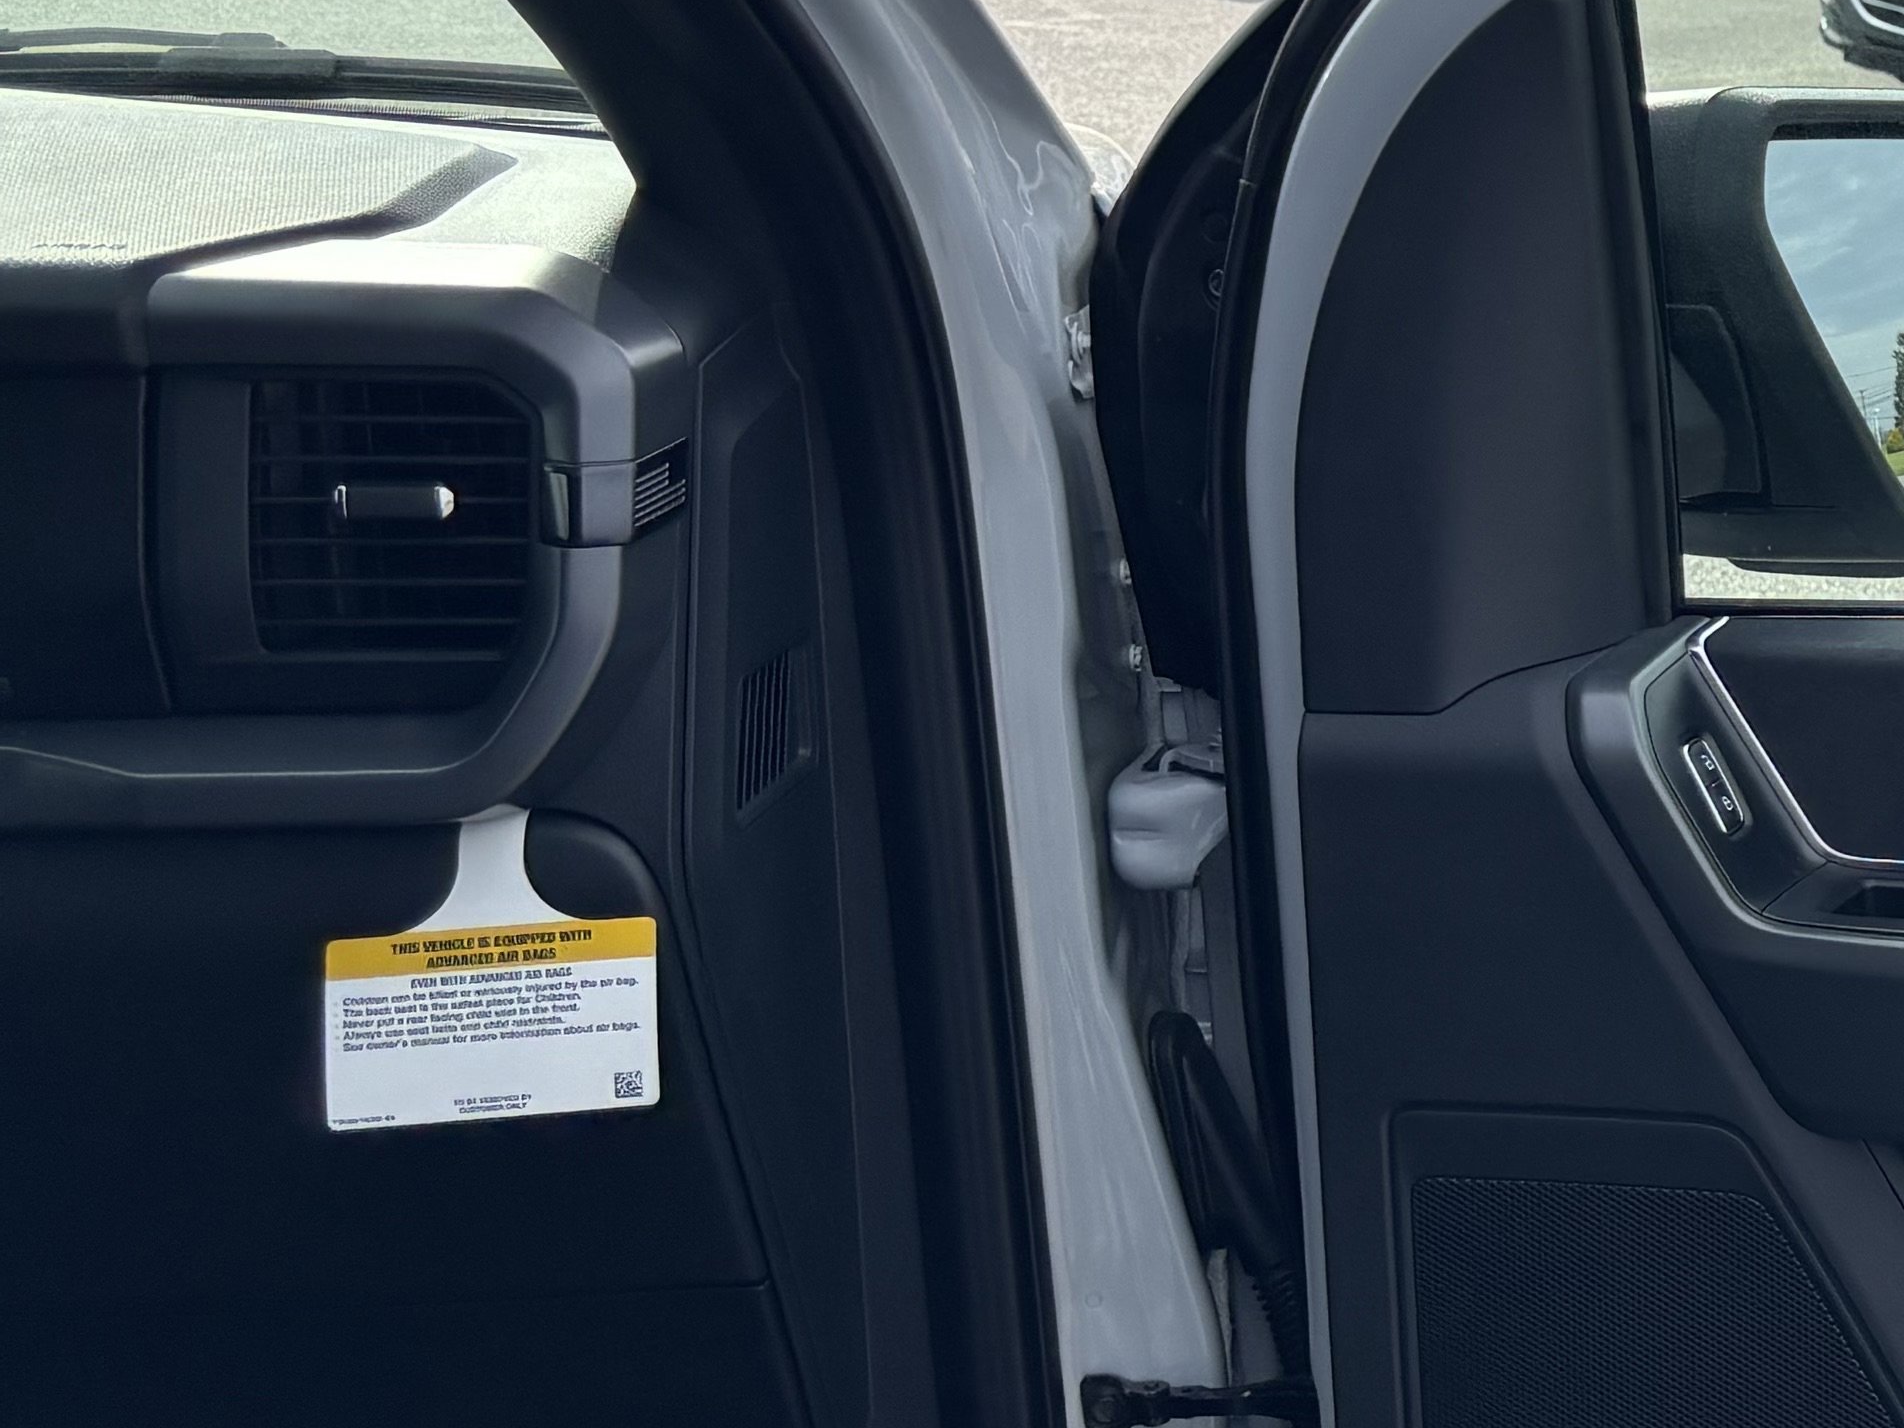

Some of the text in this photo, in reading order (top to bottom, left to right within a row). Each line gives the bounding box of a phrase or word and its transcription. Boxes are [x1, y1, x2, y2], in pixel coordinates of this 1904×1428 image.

[391, 942, 420, 955] THIS
[422, 938, 474, 952] VEHICLE
[494, 932, 556, 947] EQUIPPED
[559, 929, 591, 942] WITH
[426, 947, 556, 968] ADVANCED AIR BAGS
